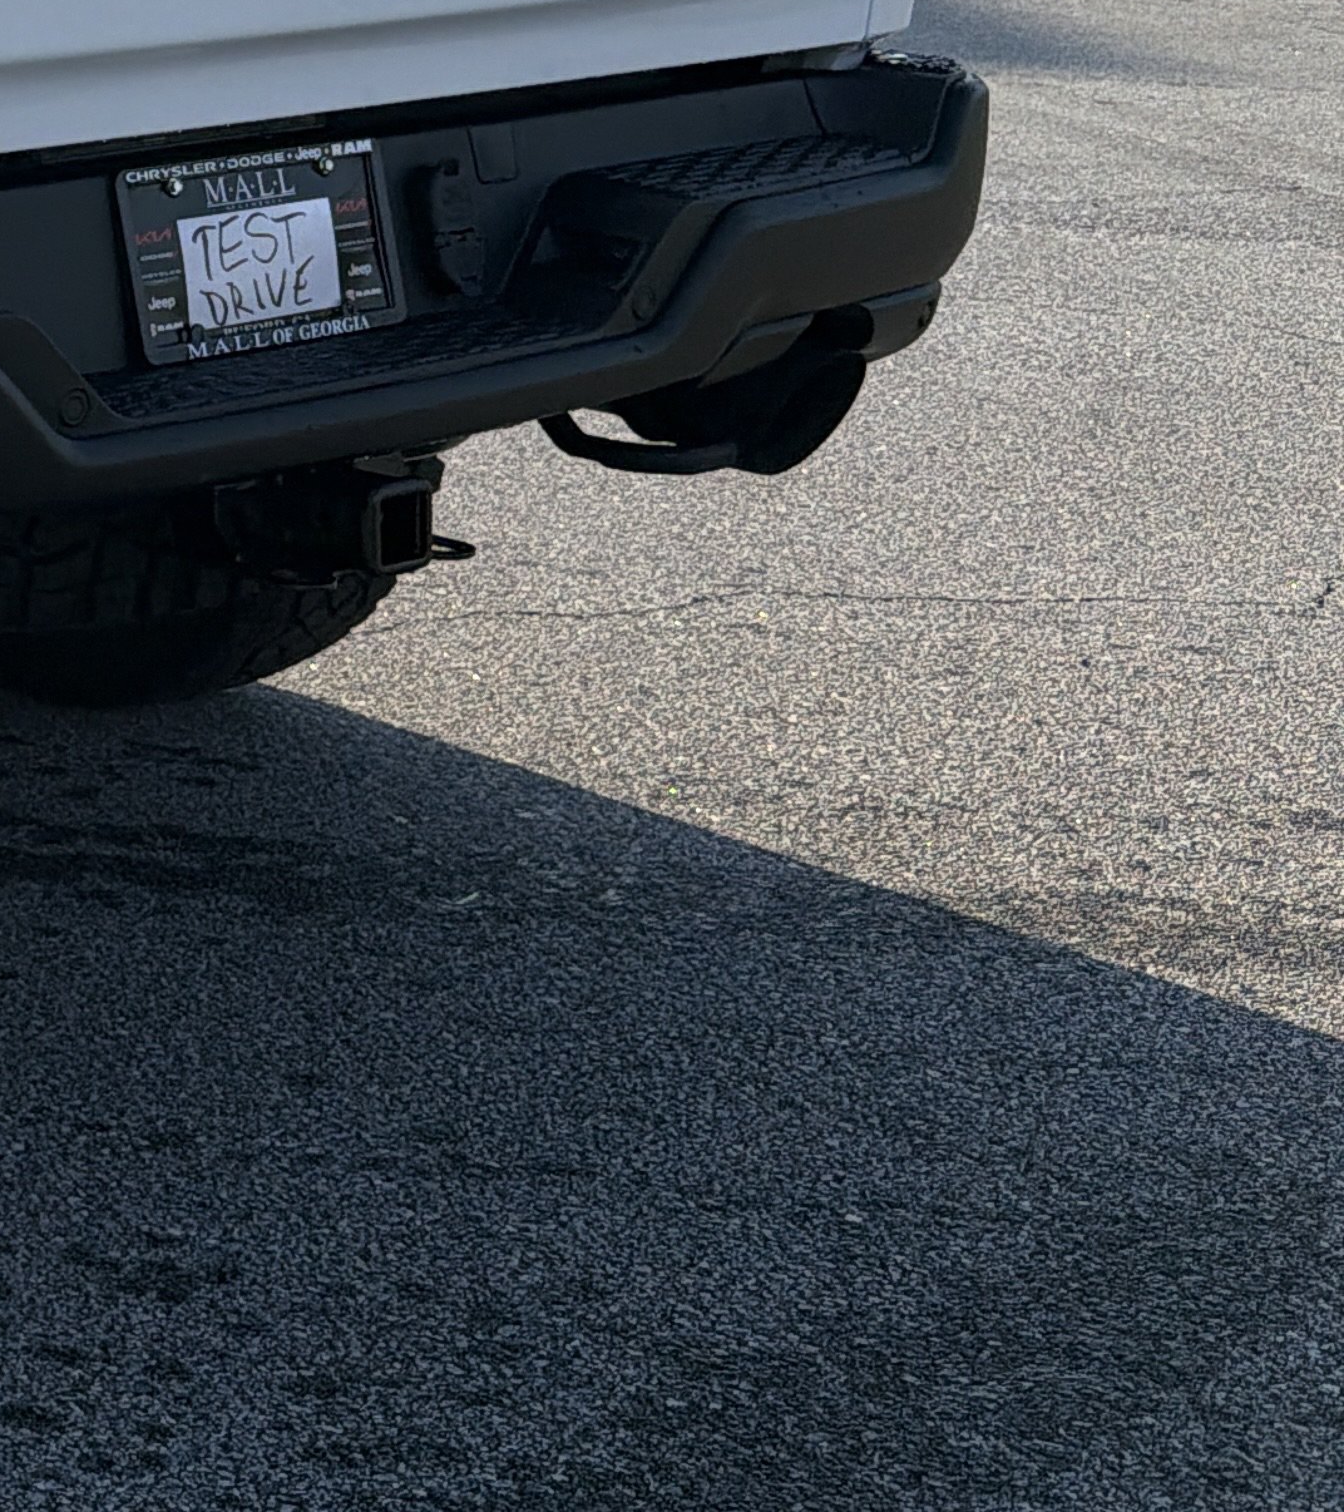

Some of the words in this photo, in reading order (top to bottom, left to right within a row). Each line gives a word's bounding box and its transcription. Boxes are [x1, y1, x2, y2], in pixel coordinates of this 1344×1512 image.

[125, 161, 217, 184] CHRYSLER
[227, 152, 285, 170] DODGE
[294, 145, 322, 161] Jeep
[331, 139, 373, 156] RAM
[192, 211, 306, 281] TEST
[347, 262, 372, 278] Jeep
[147, 295, 176, 312] Jeep
[199, 255, 315, 327] DRIVE
[272, 326, 294, 346] OF
[298, 315, 370, 341] GEORGIA
